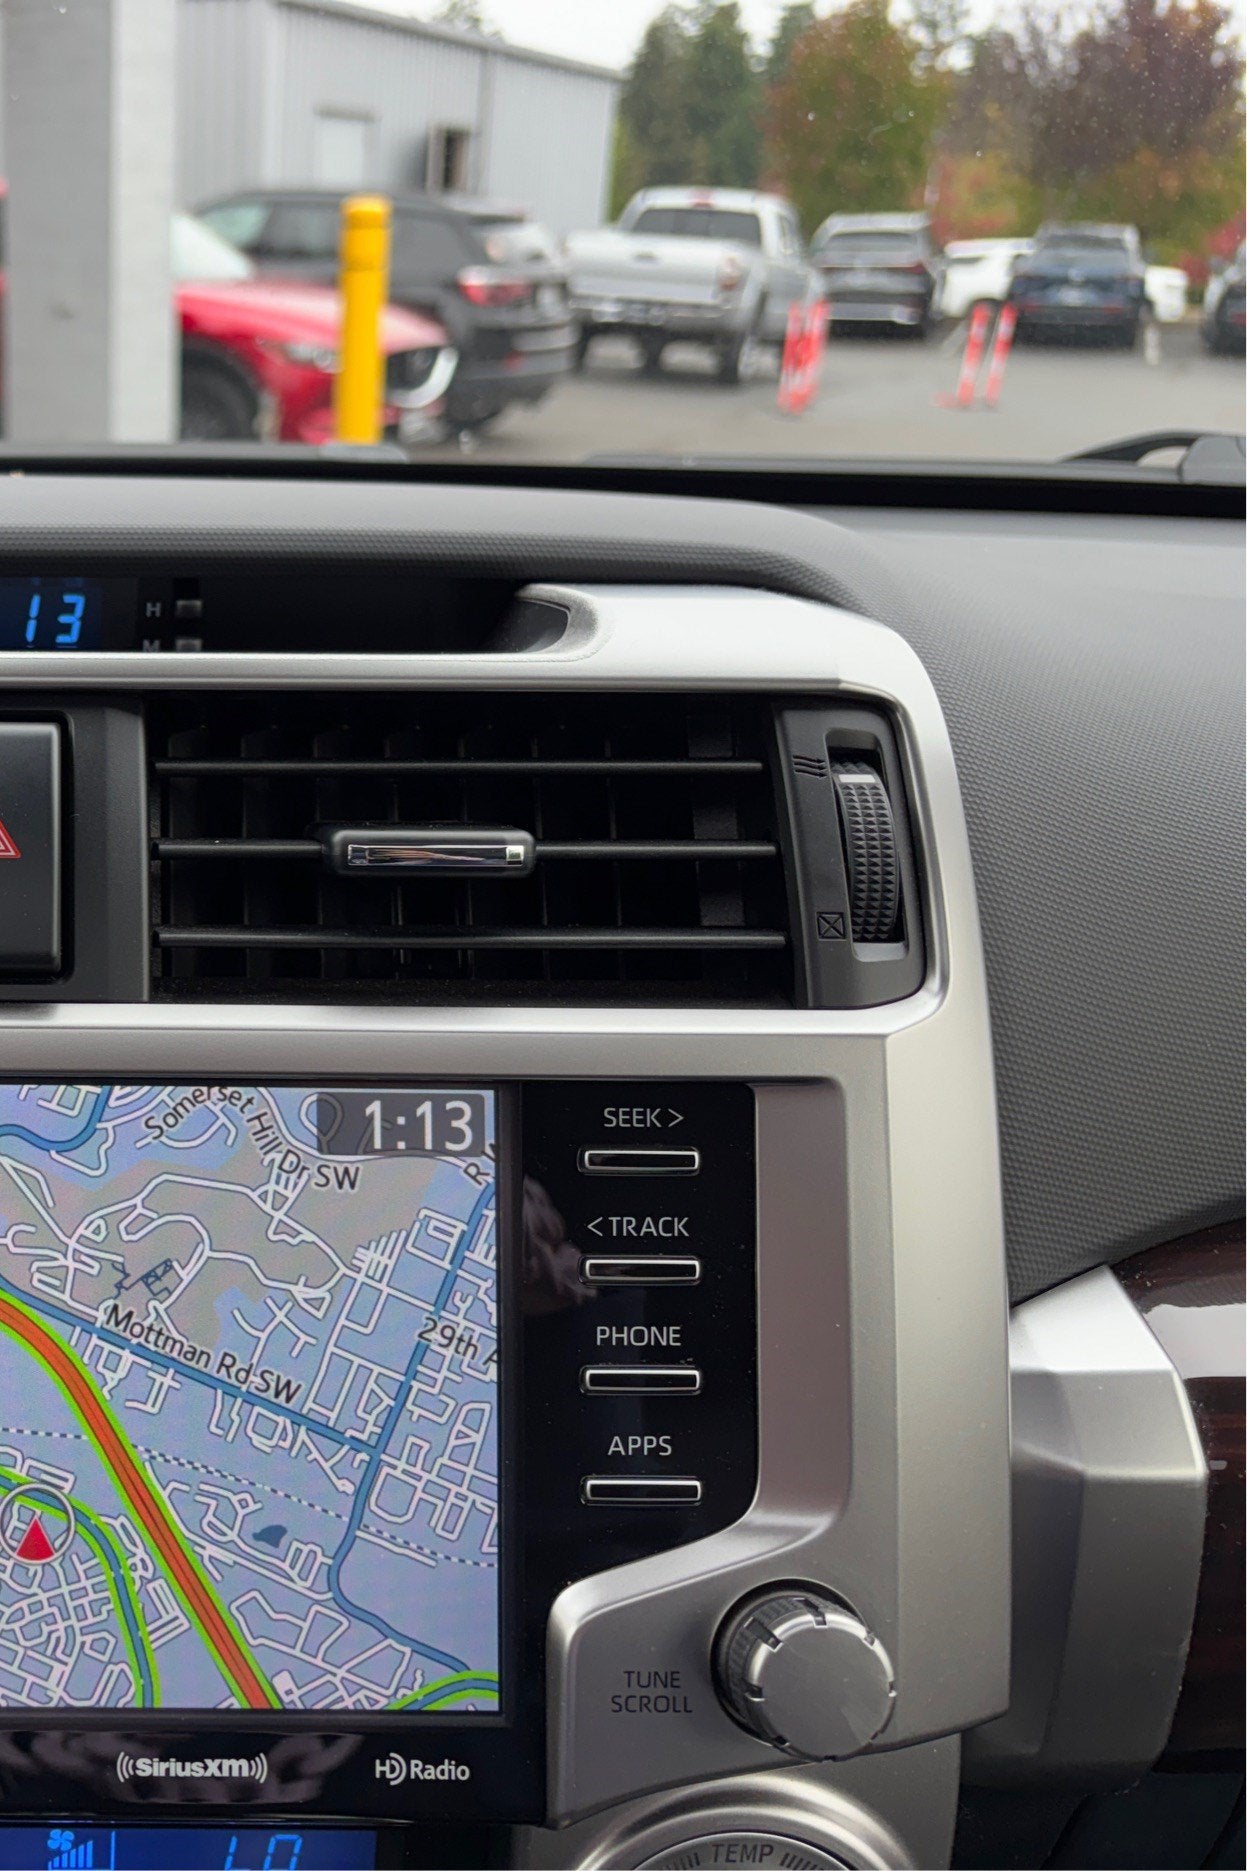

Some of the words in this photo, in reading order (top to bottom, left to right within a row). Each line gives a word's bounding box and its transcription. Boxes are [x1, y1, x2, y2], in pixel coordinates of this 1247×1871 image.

[145, 602, 161, 617] H
[365, 1100, 473, 1152] 1:13
[603, 1107, 662, 1128] SEEK
[144, 1086, 255, 1140] Somerset
[246, 1111, 285, 1156] Hill
[278, 1149, 310, 1183] Dr
[314, 1164, 360, 1190] SW
[608, 1216, 690, 1237] TRACK
[417, 1316, 478, 1360] 29th
[596, 1326, 682, 1346] PHONE
[106, 1303, 212, 1369] Mottman
[216, 1351, 254, 1386] Rd
[254, 1369, 303, 1405] SW
[607, 1436, 673, 1456] APPS
[623, 1670, 681, 1689] TUNE
[611, 1695, 694, 1713] SCROLL
[410, 1758, 470, 1781] Radio
[711, 1843, 774, 1864] TEMP
